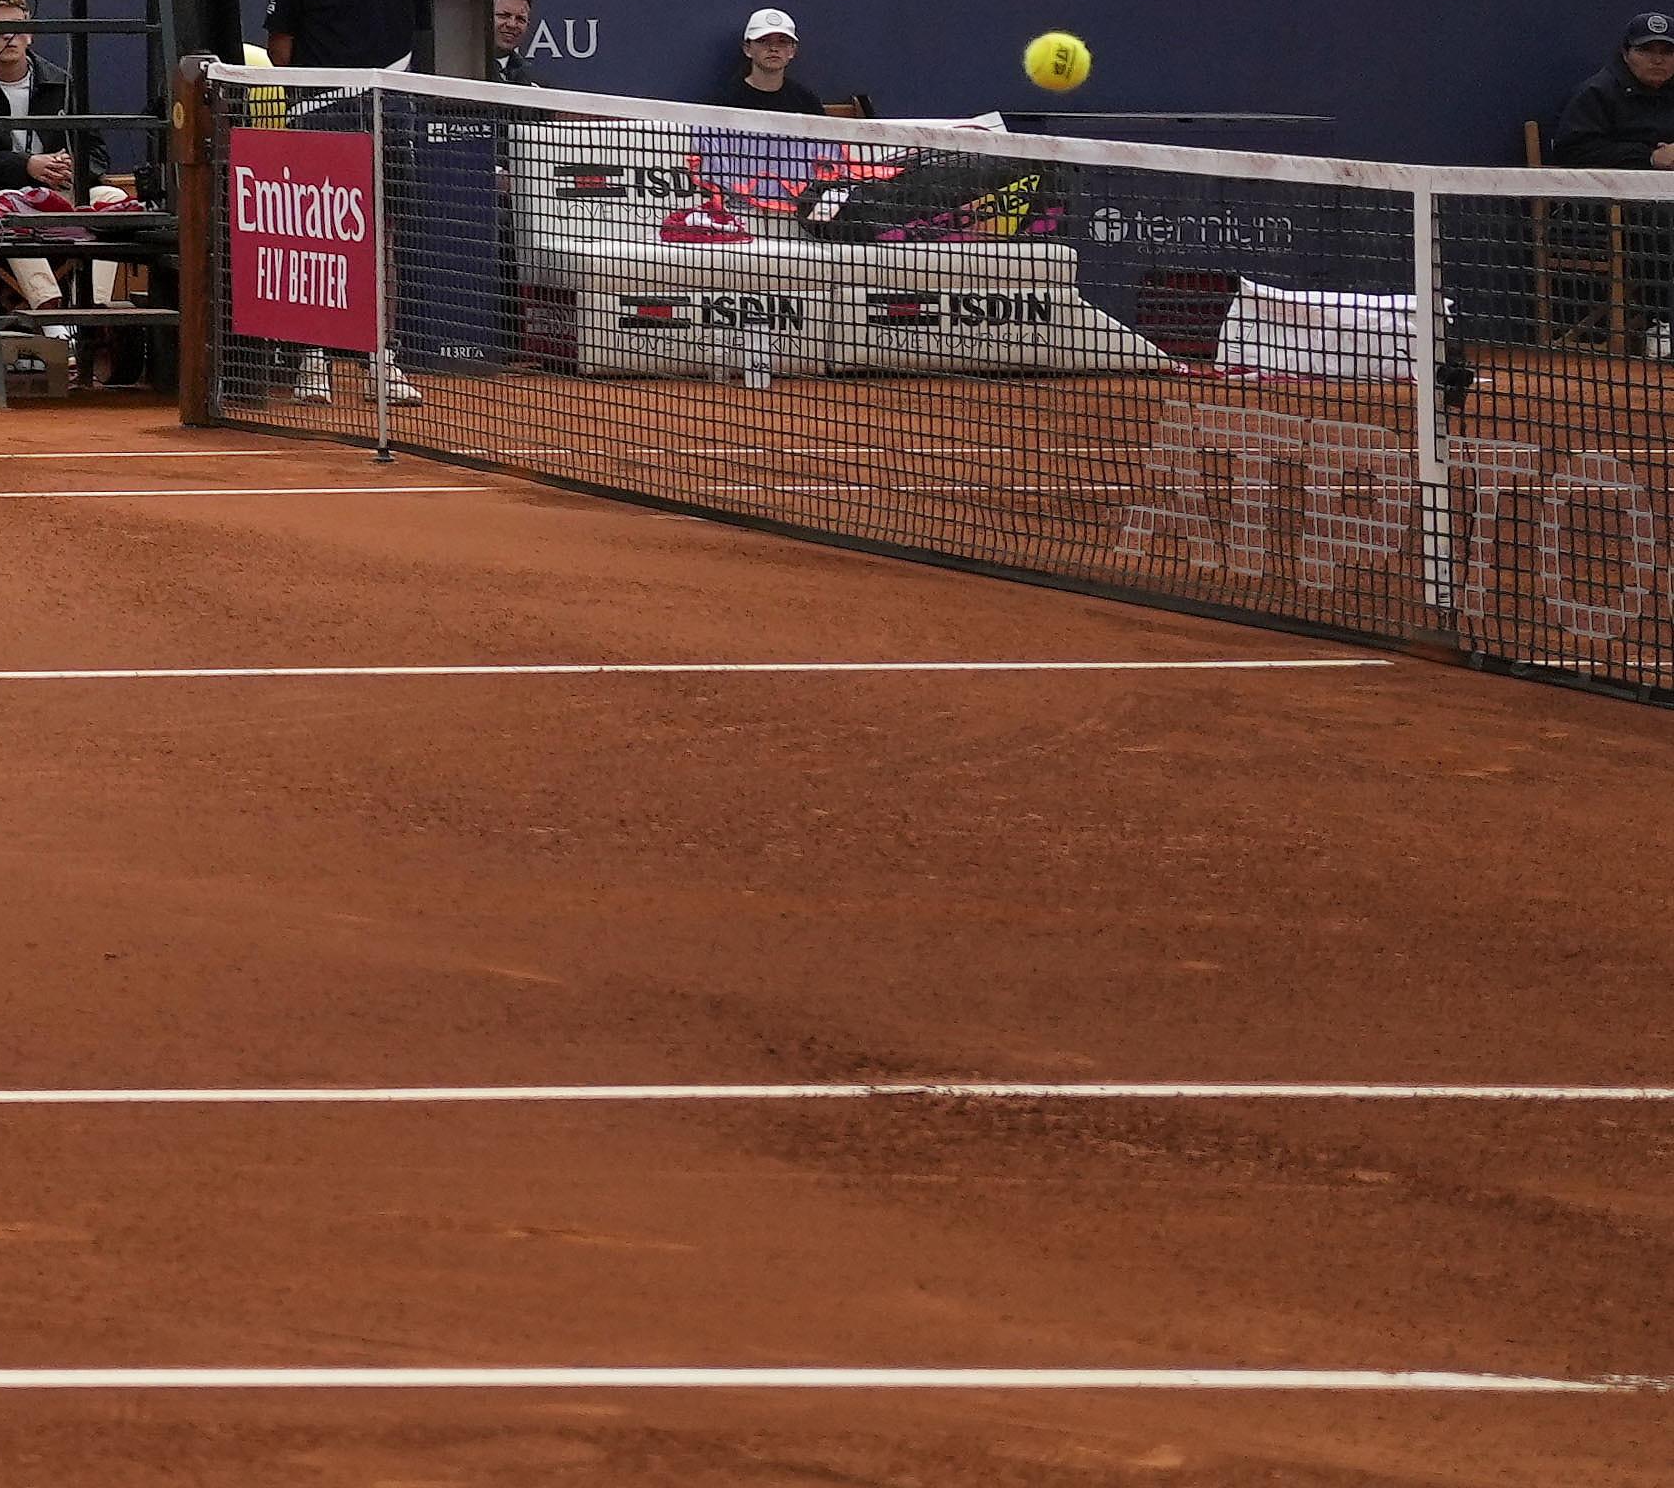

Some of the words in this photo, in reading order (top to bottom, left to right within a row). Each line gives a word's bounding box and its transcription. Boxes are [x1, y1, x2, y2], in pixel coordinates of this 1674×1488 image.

[235, 164, 365, 243] Emirates
[635, 167, 698, 198] ISD
[256, 247, 285, 302] FLY
[289, 253, 348, 311] BETTER
[701, 295, 804, 331] ISDIN
[951, 292, 1051, 326] ISDIN
[1442, 435, 1674, 639] TO
